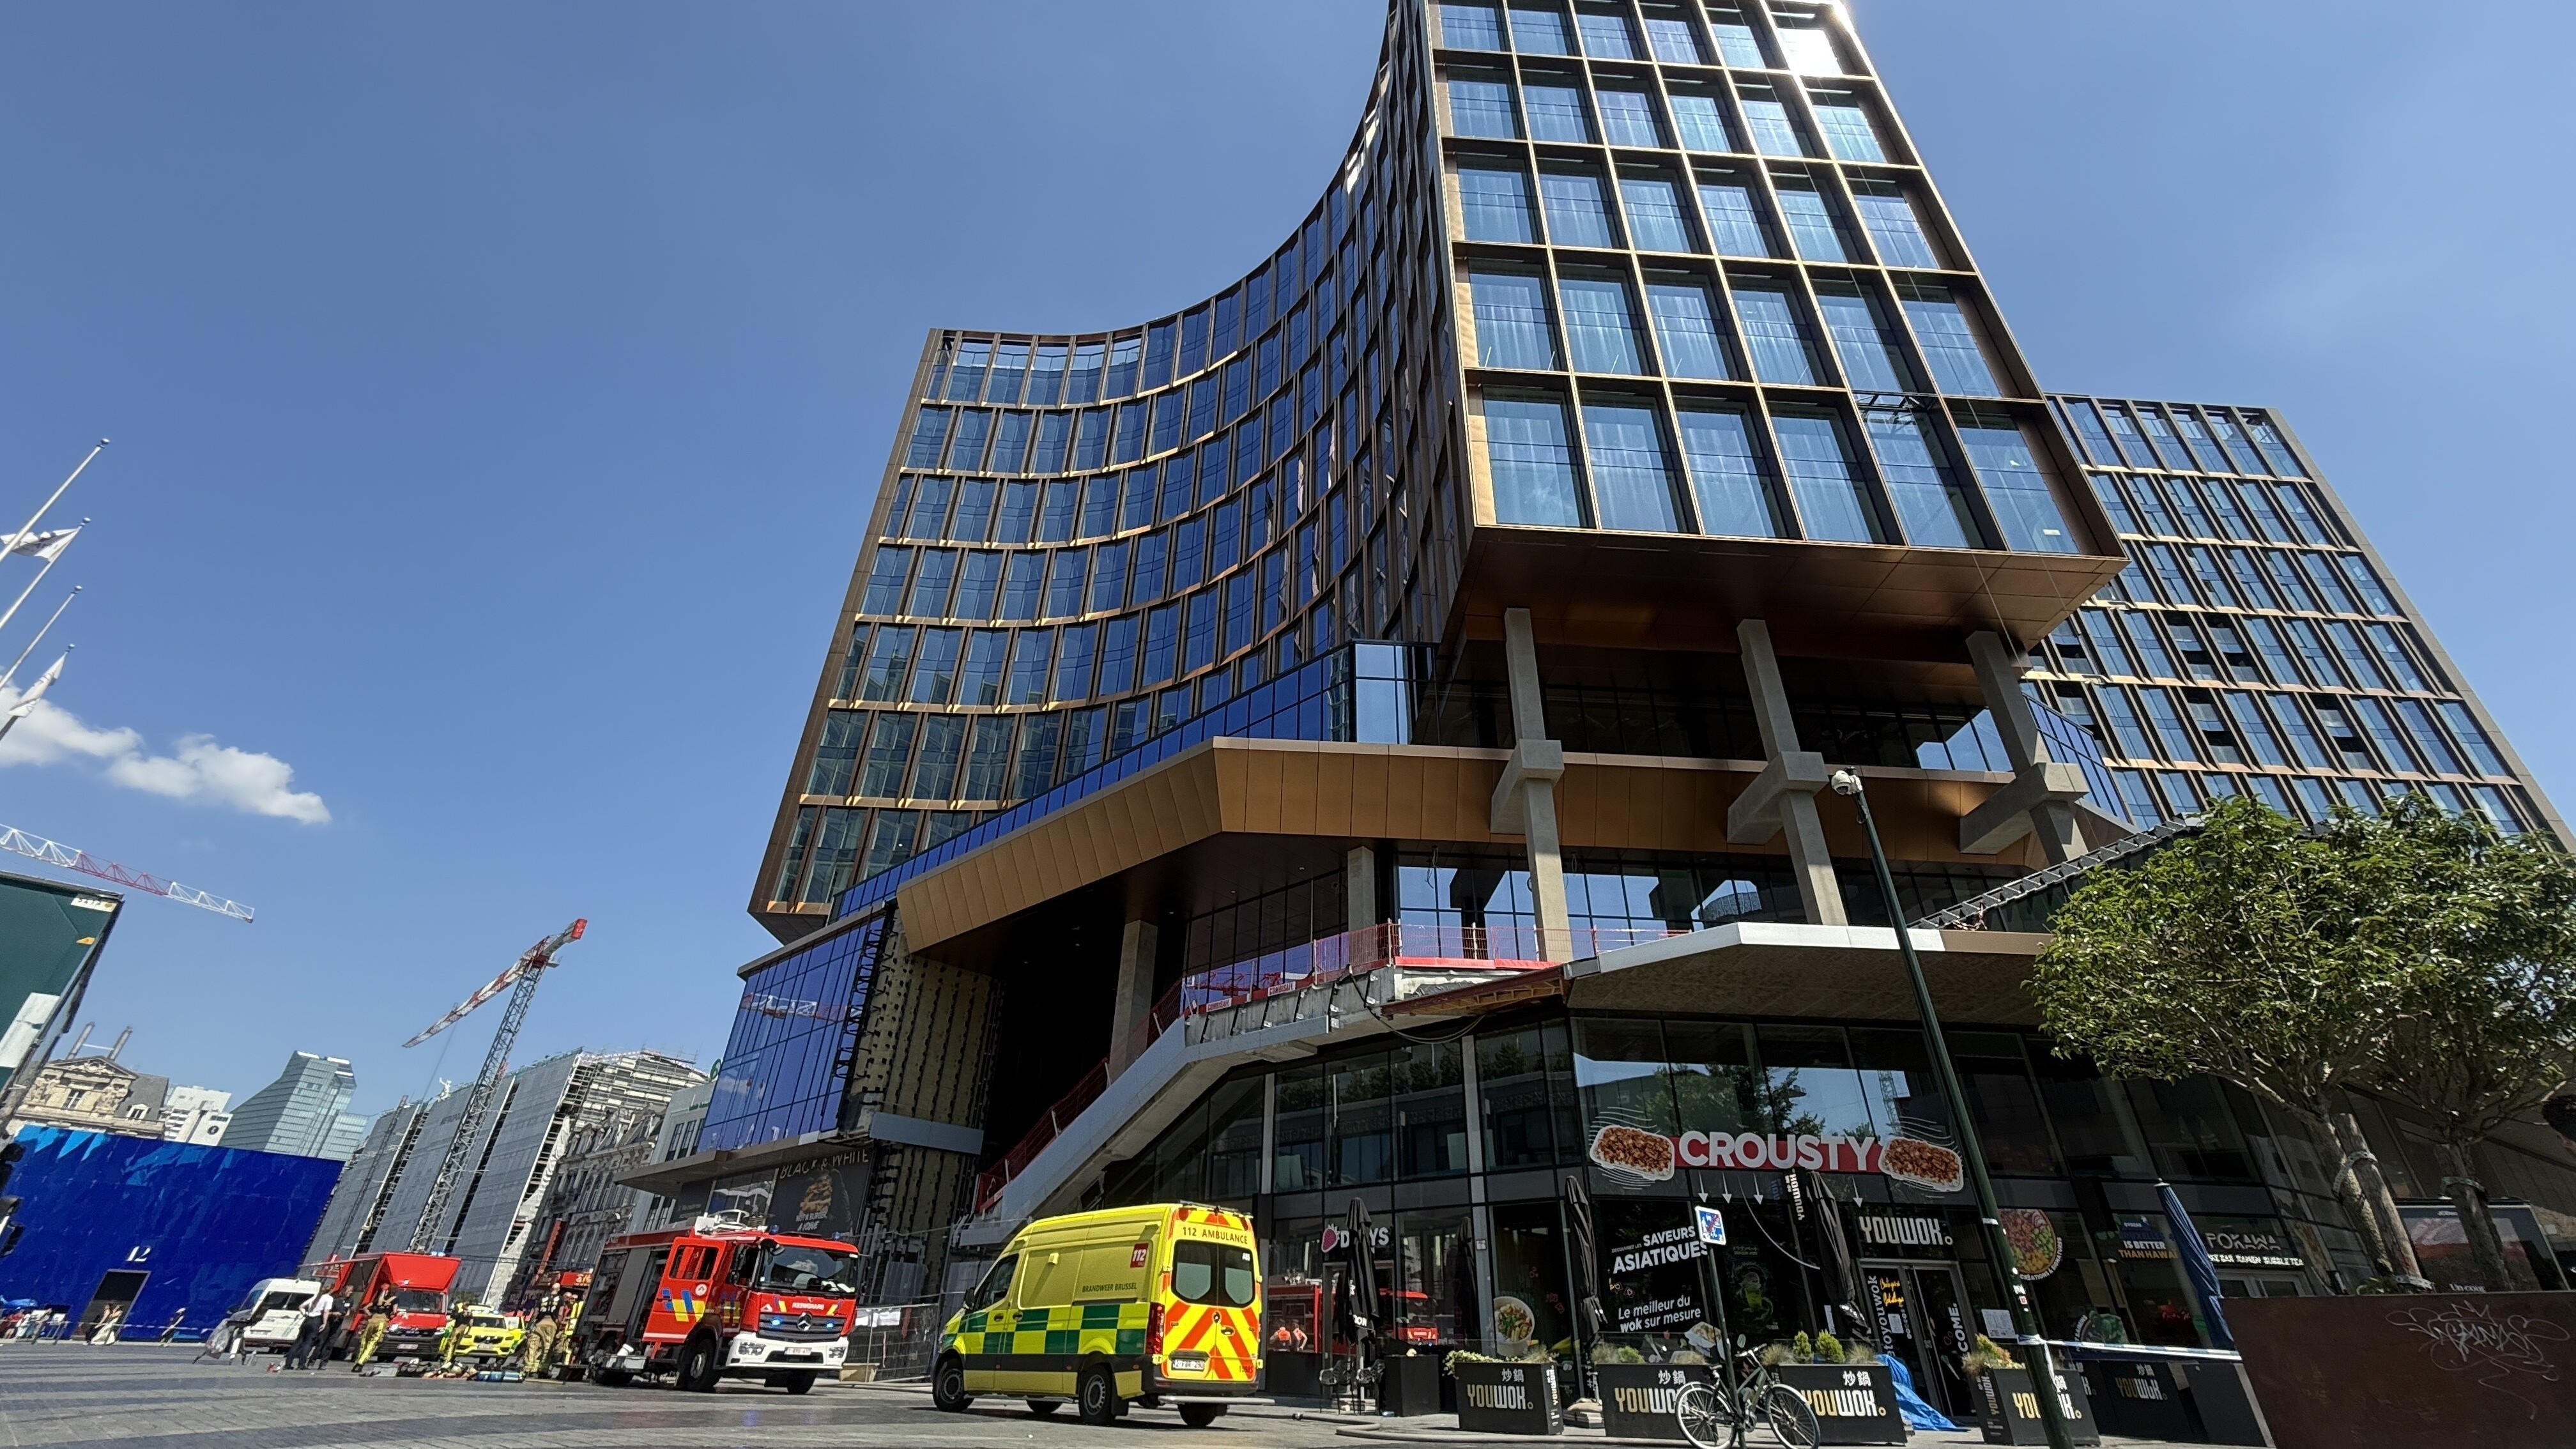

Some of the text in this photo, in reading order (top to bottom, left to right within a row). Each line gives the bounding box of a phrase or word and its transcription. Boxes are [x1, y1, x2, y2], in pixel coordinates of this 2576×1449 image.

[1678, 1129, 1875, 1172] CROUSTY
[1183, 1226, 1248, 1245] 112 AMBULANCE
[1643, 1225, 1696, 1247] SAVEURS
[2122, 1240, 2166, 1250] IS BETTER
[125, 1245, 151, 1262] 12
[1131, 1248, 1146, 1262] 112
[1613, 1239, 1708, 1275] ASIATIQUES
[2118, 1249, 2145, 1259] THAN
[1082, 1282, 1137, 1292] BRANDWEER BRUSSEL
[1618, 1294, 1690, 1320] Le meilleur du
[1620, 1308, 1701, 1333] wok sur mesure
